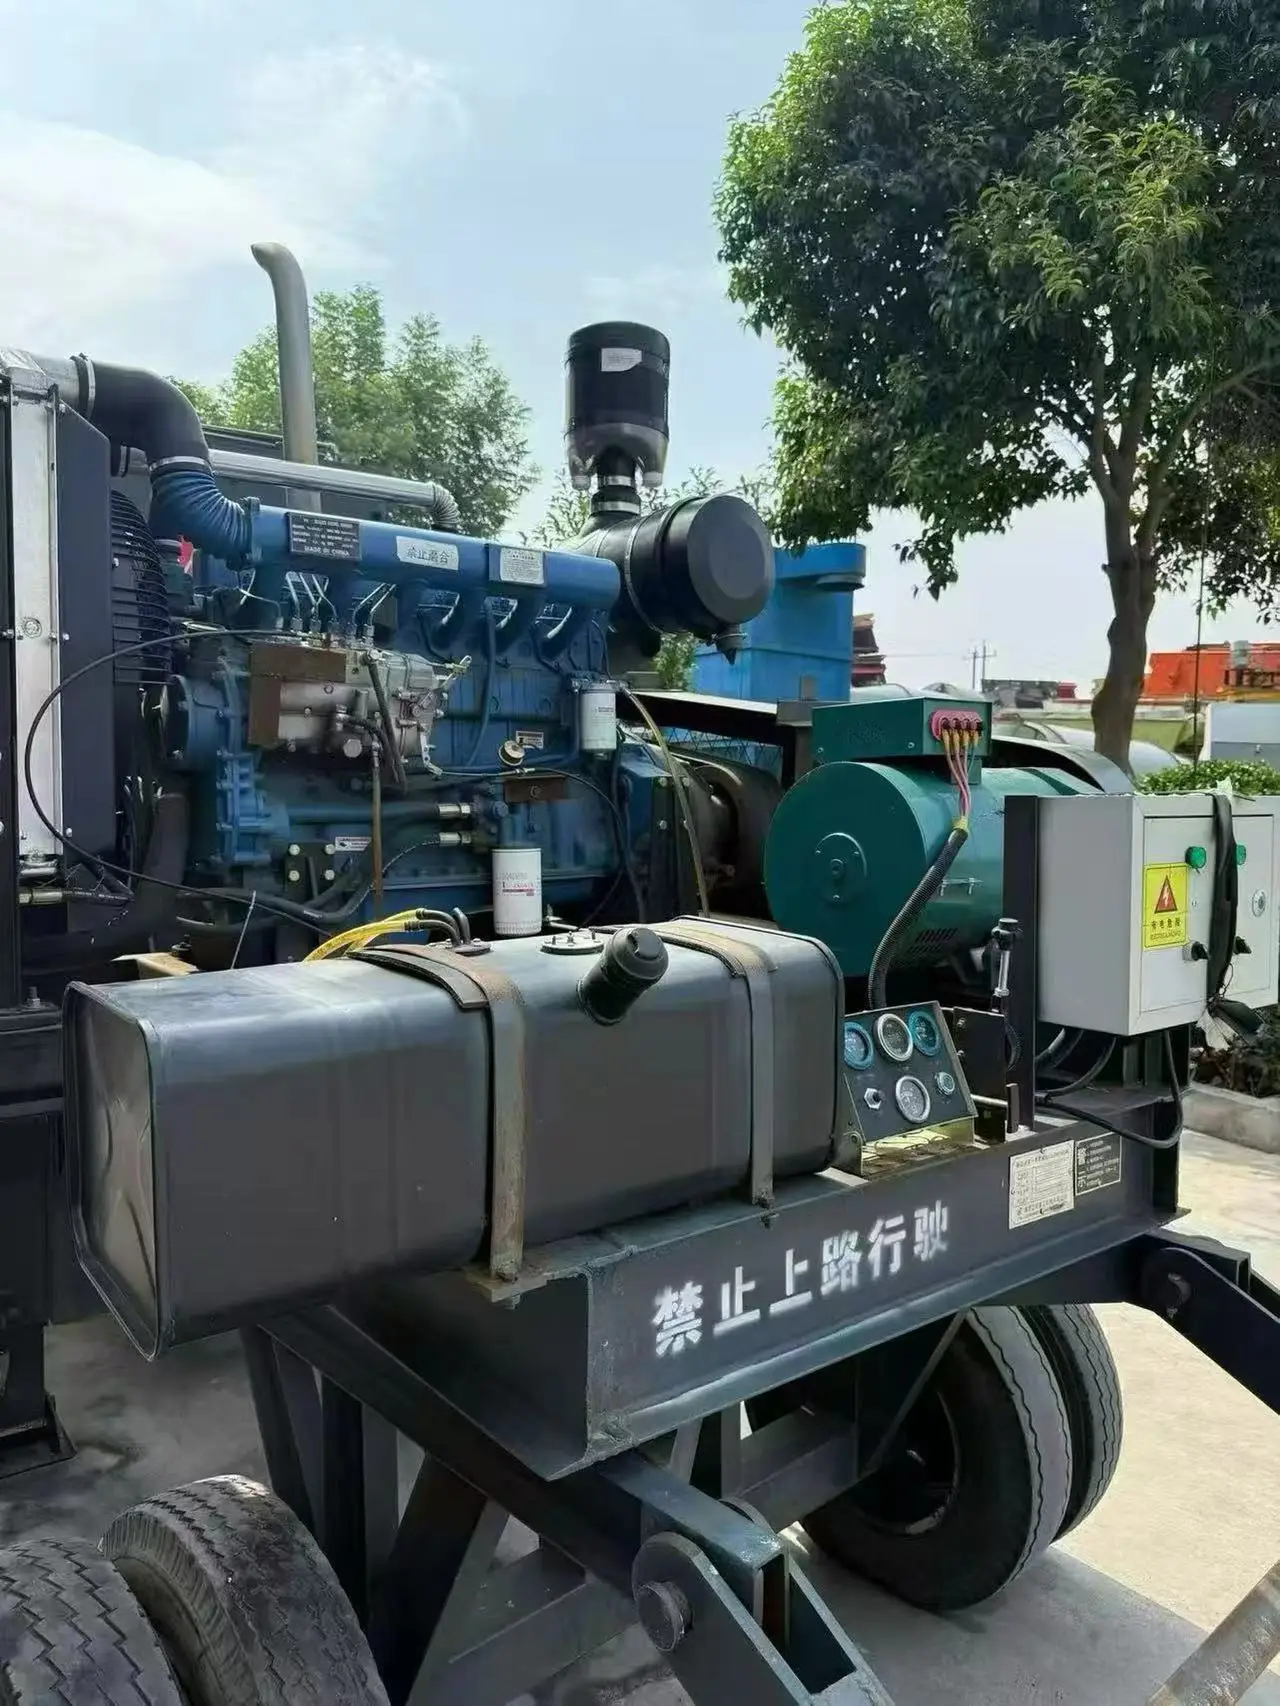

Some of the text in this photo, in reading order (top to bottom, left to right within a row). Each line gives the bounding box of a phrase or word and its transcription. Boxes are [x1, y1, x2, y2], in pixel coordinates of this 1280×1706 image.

[652, 1199, 948, 1356] 禁止上路行驶
